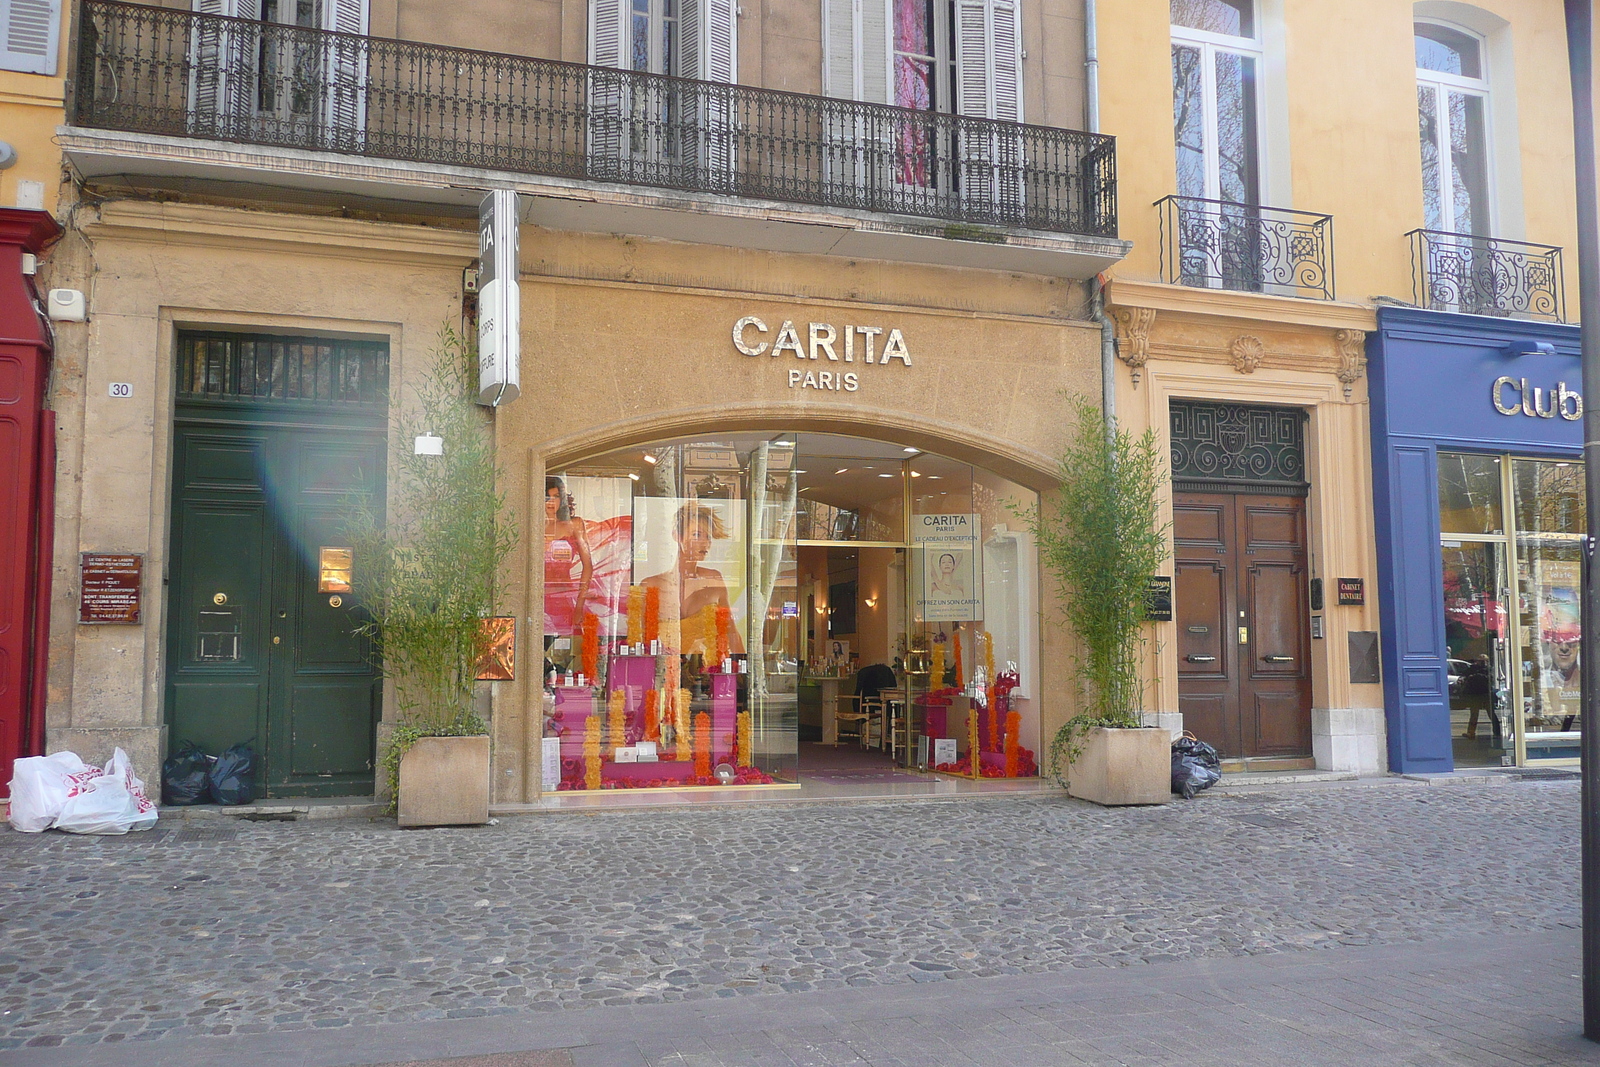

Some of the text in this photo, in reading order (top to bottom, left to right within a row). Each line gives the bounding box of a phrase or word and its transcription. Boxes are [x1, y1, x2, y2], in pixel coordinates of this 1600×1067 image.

[732, 315, 912, 367] CARITA
[788, 369, 859, 392] PARIS
[113, 384, 129, 396] 30
[1493, 376, 1583, 421] Club
[923, 515, 967, 526] CARITA
[1340, 592, 1362, 600] DENTAIRE
